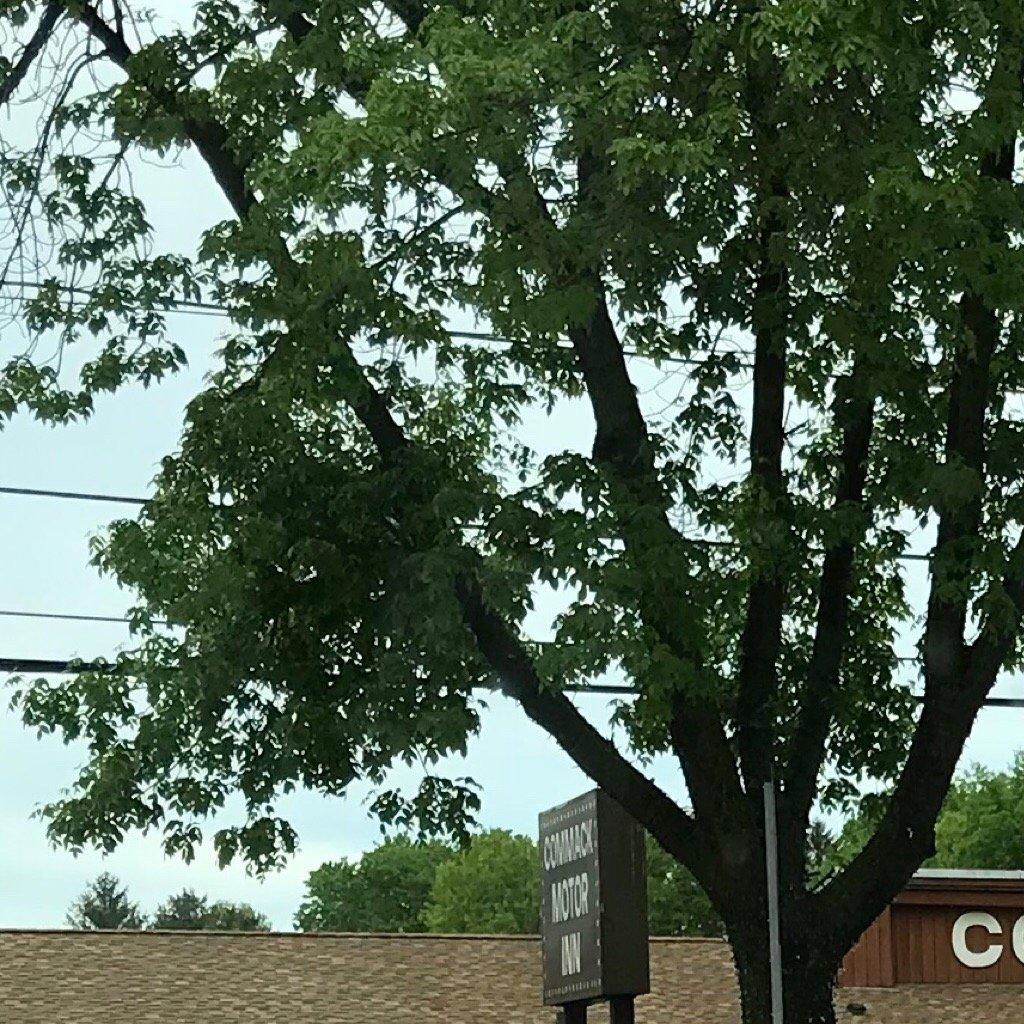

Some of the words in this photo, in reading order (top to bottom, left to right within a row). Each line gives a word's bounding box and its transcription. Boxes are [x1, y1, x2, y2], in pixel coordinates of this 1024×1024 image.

[543, 818, 594, 872] COMMACK
[551, 872, 589, 924] MOTOR
[561, 931, 581, 977] INN
